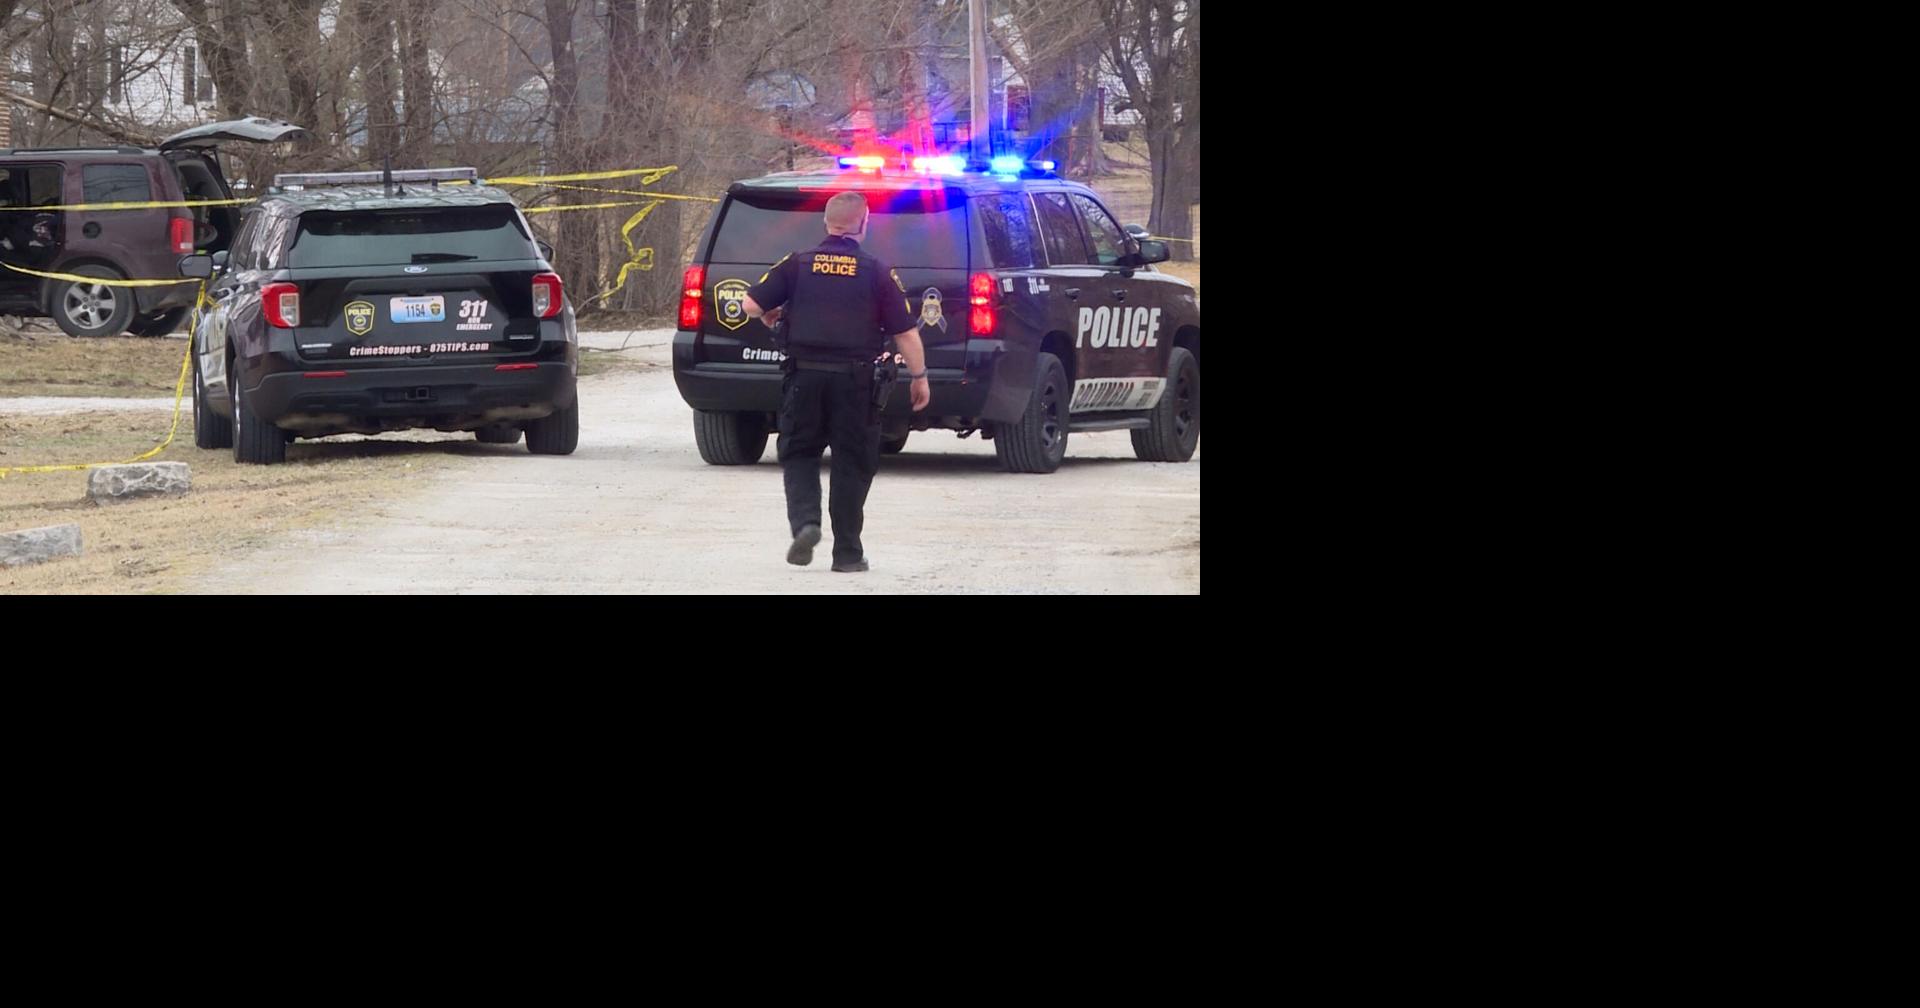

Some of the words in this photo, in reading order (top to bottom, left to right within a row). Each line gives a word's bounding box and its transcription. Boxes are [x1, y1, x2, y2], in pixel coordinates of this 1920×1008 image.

[815, 254, 857, 265] COLUMBIA
[812, 262, 857, 276] POLICE
[458, 299, 488, 318] 311
[1075, 305, 1161, 348] POLICE
[349, 345, 422, 356] CrimeStoppers
